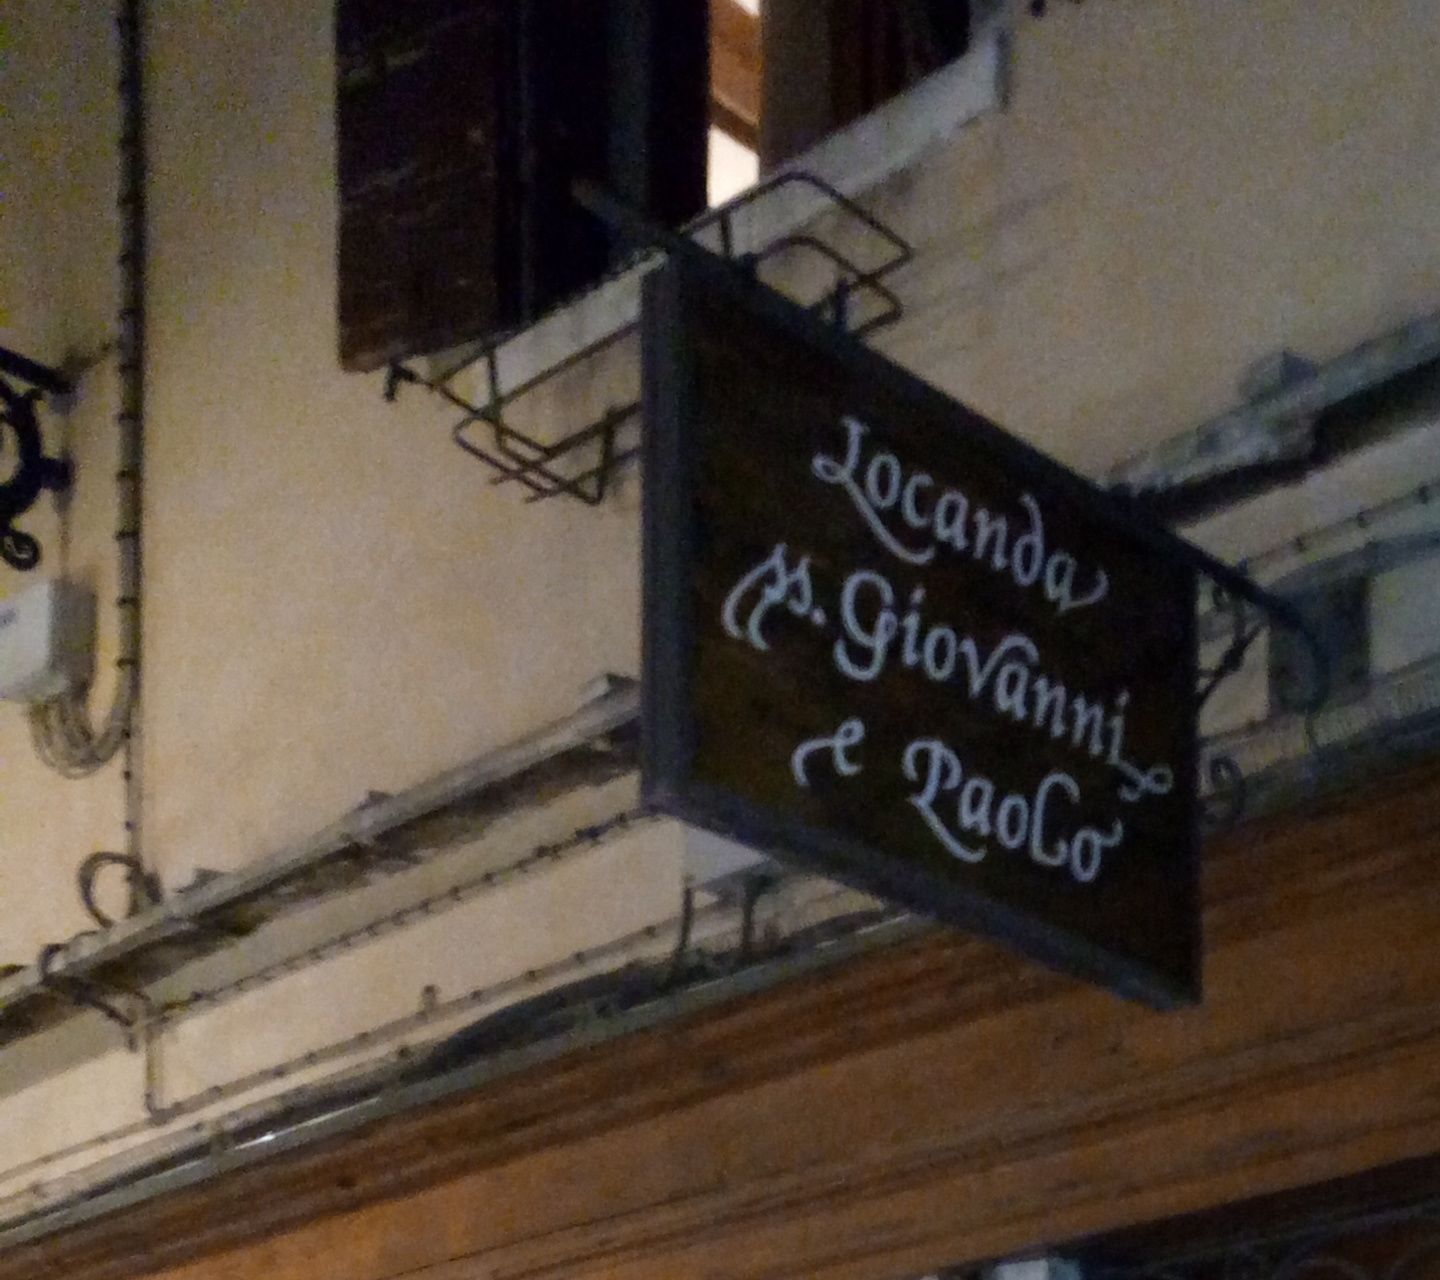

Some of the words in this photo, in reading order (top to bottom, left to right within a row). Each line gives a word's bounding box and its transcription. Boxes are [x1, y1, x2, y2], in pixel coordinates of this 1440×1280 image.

[812, 418, 1109, 612] Locanda
[834, 570, 1173, 801] Giovanni
[792, 720, 864, 787] e
[903, 739, 1122, 882] Paolo
